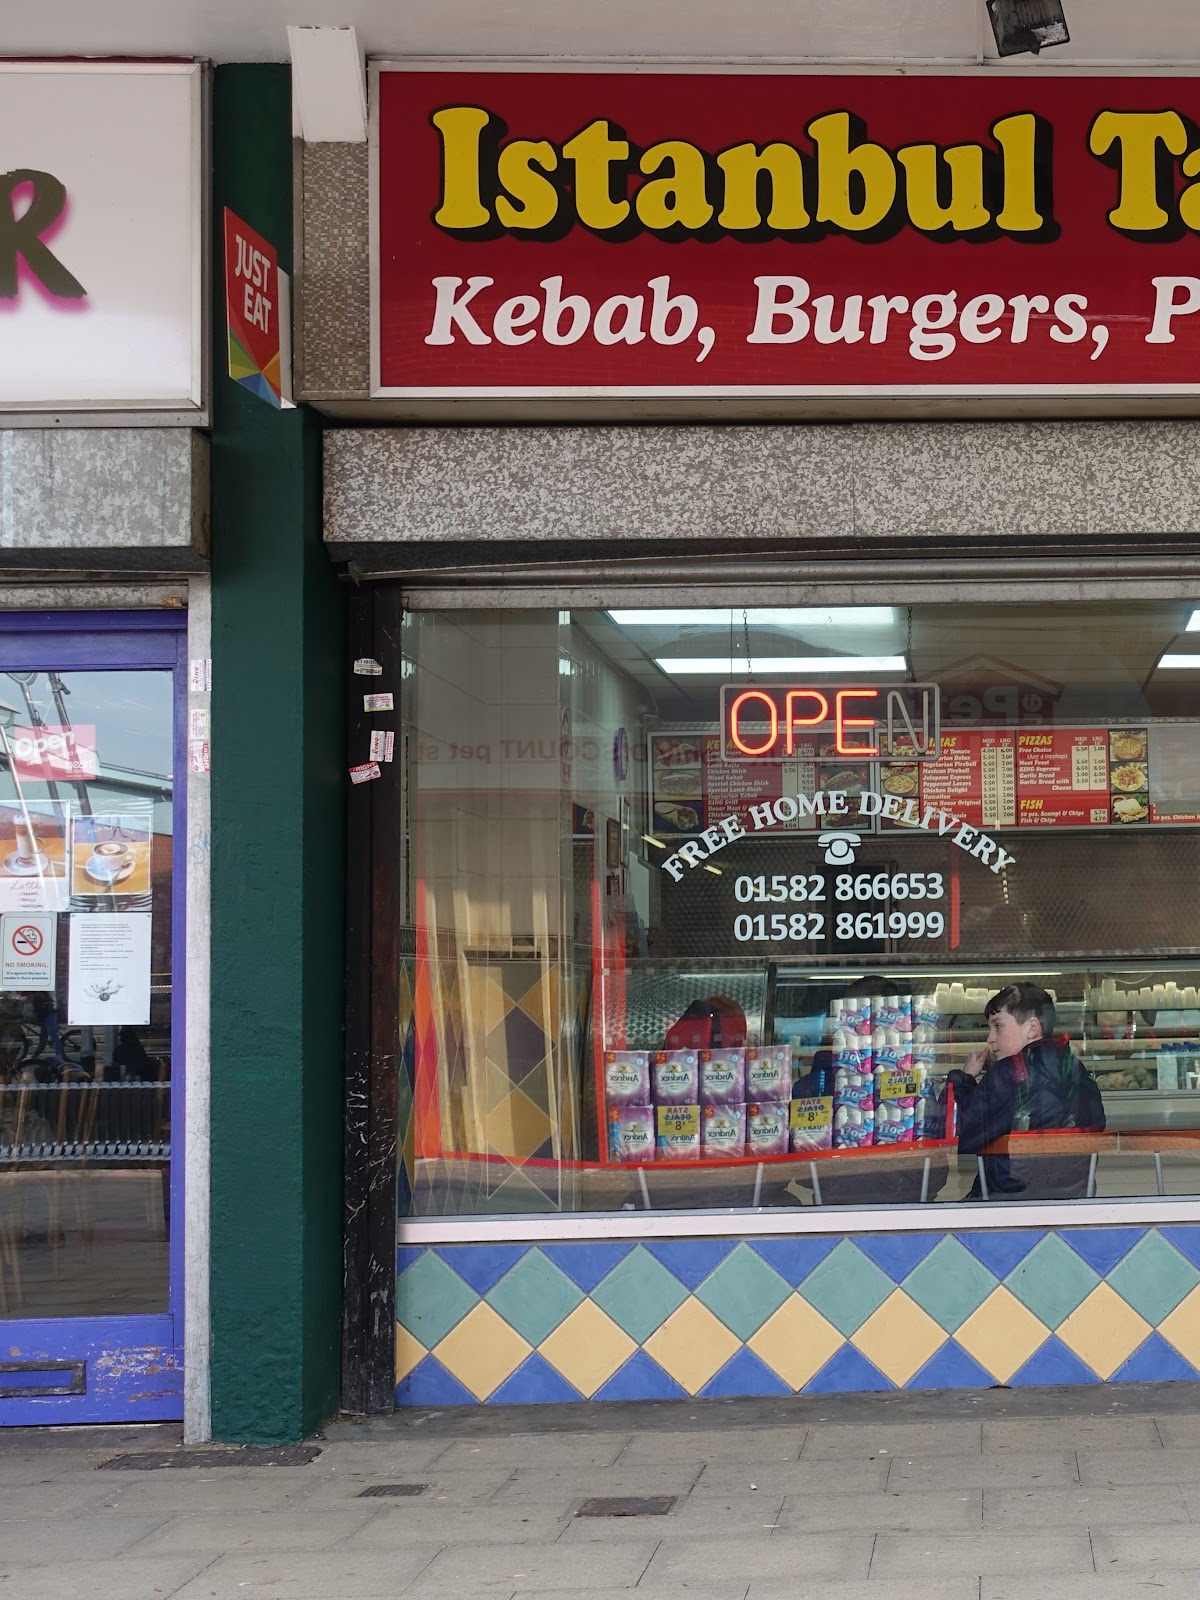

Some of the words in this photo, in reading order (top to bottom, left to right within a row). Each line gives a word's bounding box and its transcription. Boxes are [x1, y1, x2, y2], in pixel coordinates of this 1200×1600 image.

[429, 105, 1056, 239] Istanbul
[234, 234, 271, 286] JUST
[242, 289, 272, 335] EAT
[424, 275, 717, 363] Kebab,
[746, 275, 1110, 361] Burgers,
[730, 690, 929, 756] OPEN
[1019, 736, 1053, 745] PIZZAS
[1020, 800, 1043, 809] FISH
[661, 815, 747, 882] FREE
[748, 789, 850, 831] HOME
[857, 789, 1016, 875] DELIVERY
[734, 874, 826, 904] 01582
[835, 871, 944, 902] 866653
[734, 912, 826, 941] 01582
[835, 910, 945, 940] 861999
